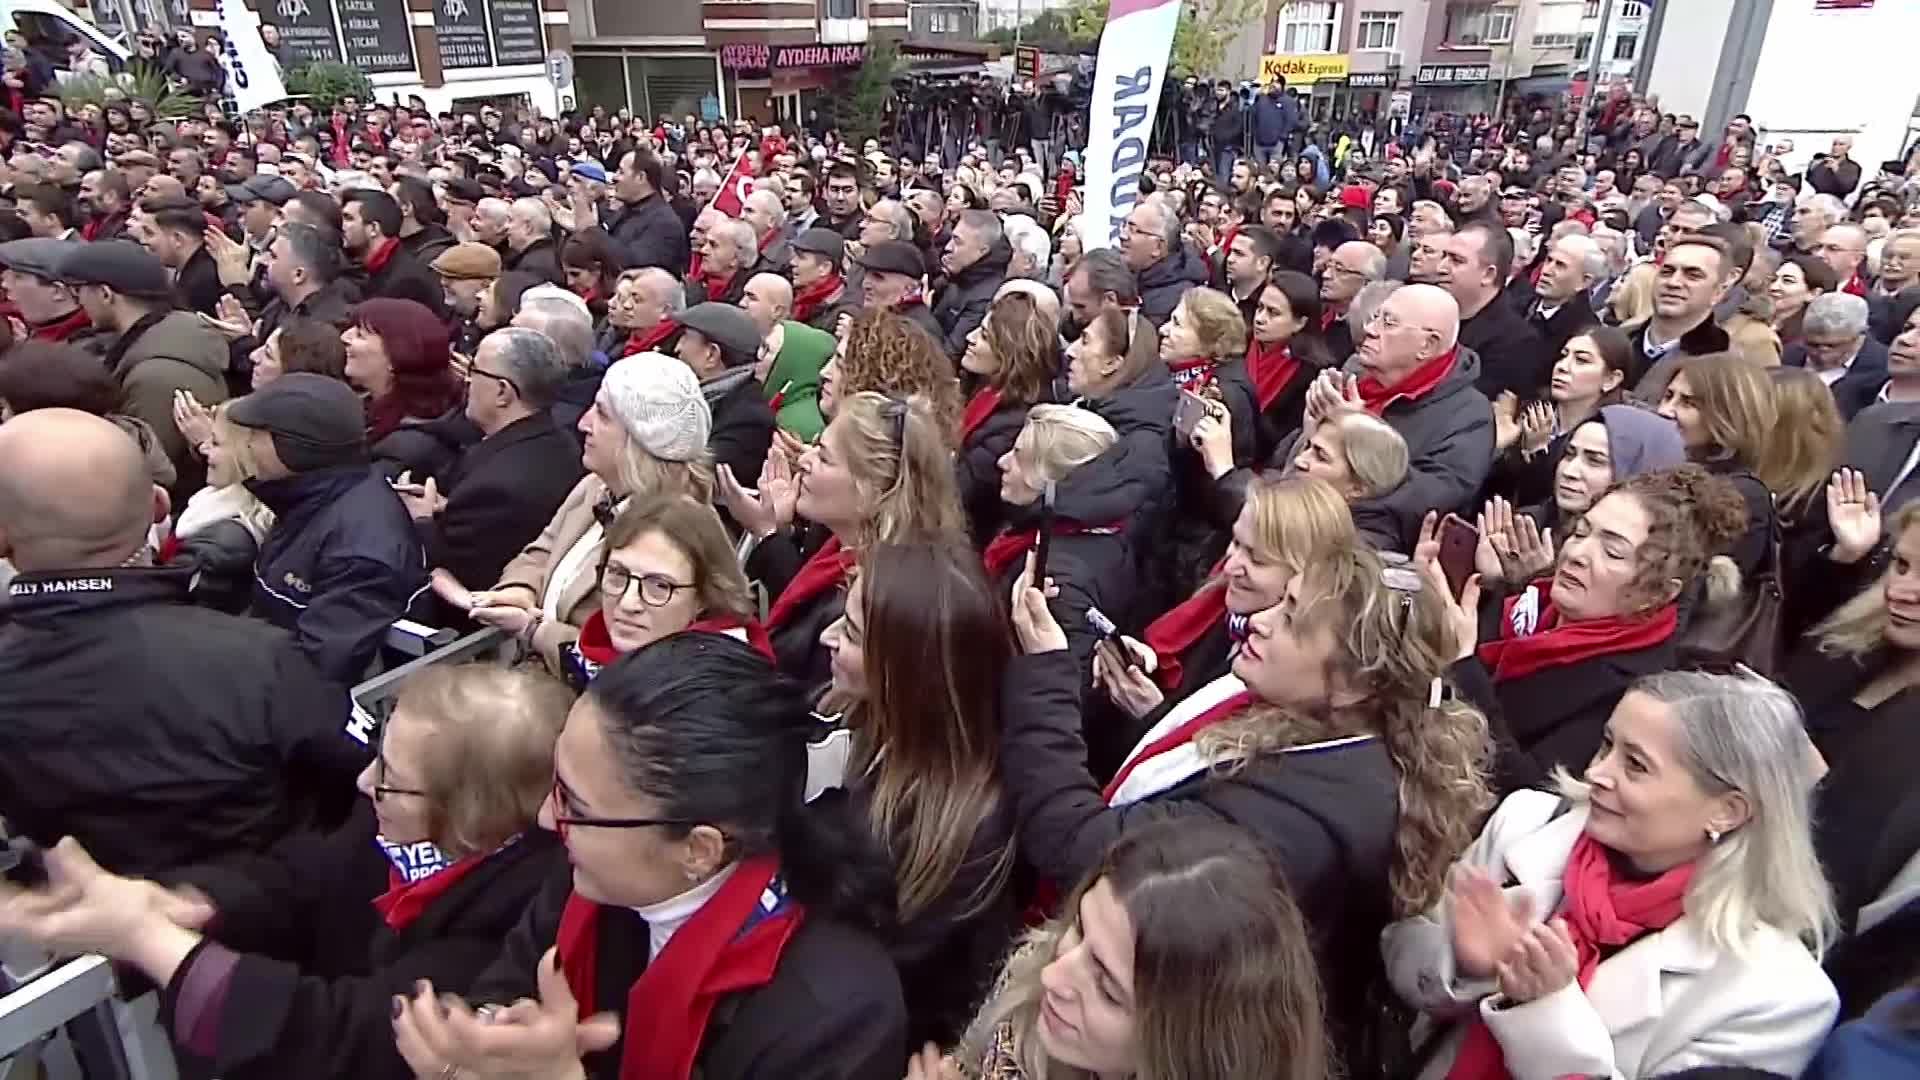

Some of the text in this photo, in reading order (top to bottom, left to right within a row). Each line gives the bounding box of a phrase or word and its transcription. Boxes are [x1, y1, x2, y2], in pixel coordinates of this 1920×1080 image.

[777, 47, 829, 66] AYDEHA
[1264, 60, 1344, 75] Kodak Express
[42, 578, 113, 593] HANSEN
